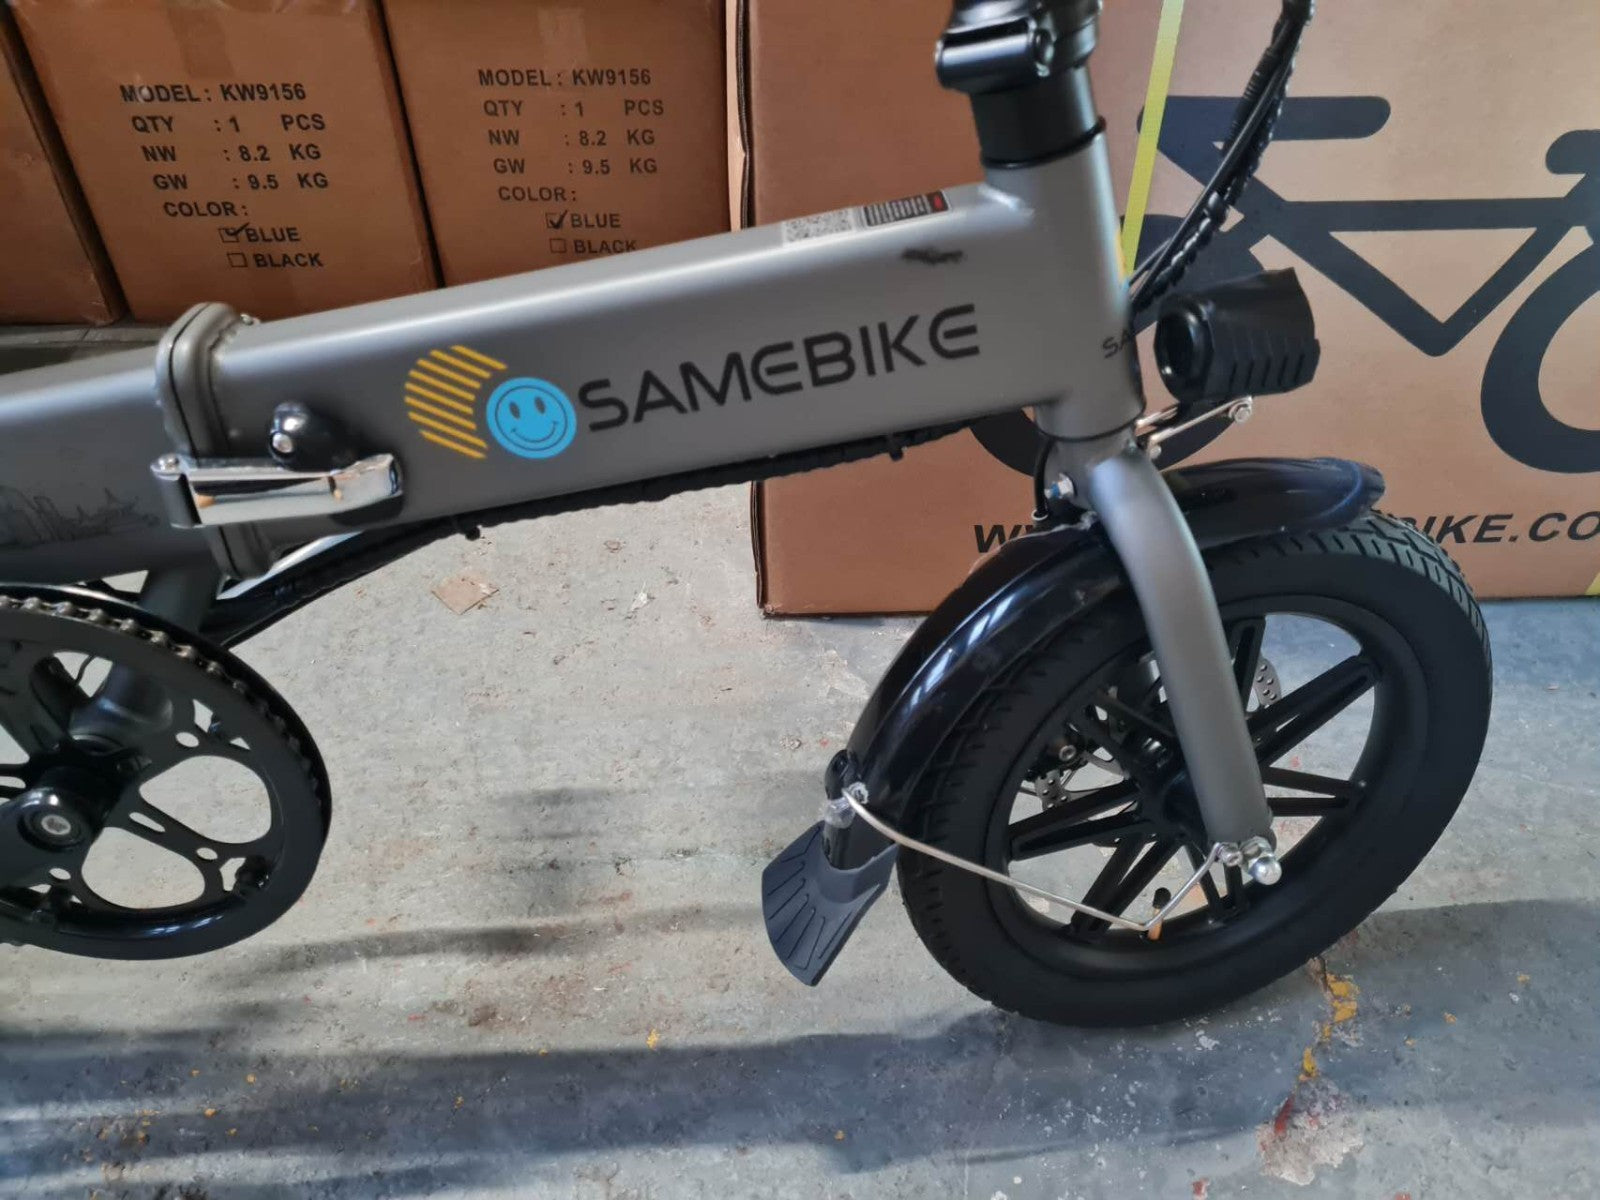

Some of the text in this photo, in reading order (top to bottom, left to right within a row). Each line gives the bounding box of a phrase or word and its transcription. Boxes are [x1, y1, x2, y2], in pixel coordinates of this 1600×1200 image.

[478, 68, 651, 87] MODEL: KW9156
[220, 83, 307, 101] KW9156
[483, 100, 523, 117] QTY
[624, 99, 664, 117] PCS
[131, 115, 174, 133] QTY
[280, 113, 326, 131] PCS
[488, 129, 520, 145] NW
[579, 130, 607, 146] 8.2
[626, 129, 655, 145] KG
[141, 145, 177, 162] NW
[238, 145, 271, 162] 8.2
[288, 143, 322, 160] KG
[493, 158, 525, 174] GW
[582, 159, 611, 175] 9.5
[629, 157, 658, 174] KG
[153, 174, 188, 190] GW
[247, 174, 279, 190] 9.5
[296, 172, 329, 189] KG
[498, 186, 577, 202] COLOR:
[163, 201, 249, 217] COLOR:
[571, 213, 621, 228] BLUE
[246, 226, 300, 243] BLUE
[573, 239, 637, 254] BLACK
[254, 253, 324, 268] BLACK
[577, 303, 981, 433] SAMEBIKE
